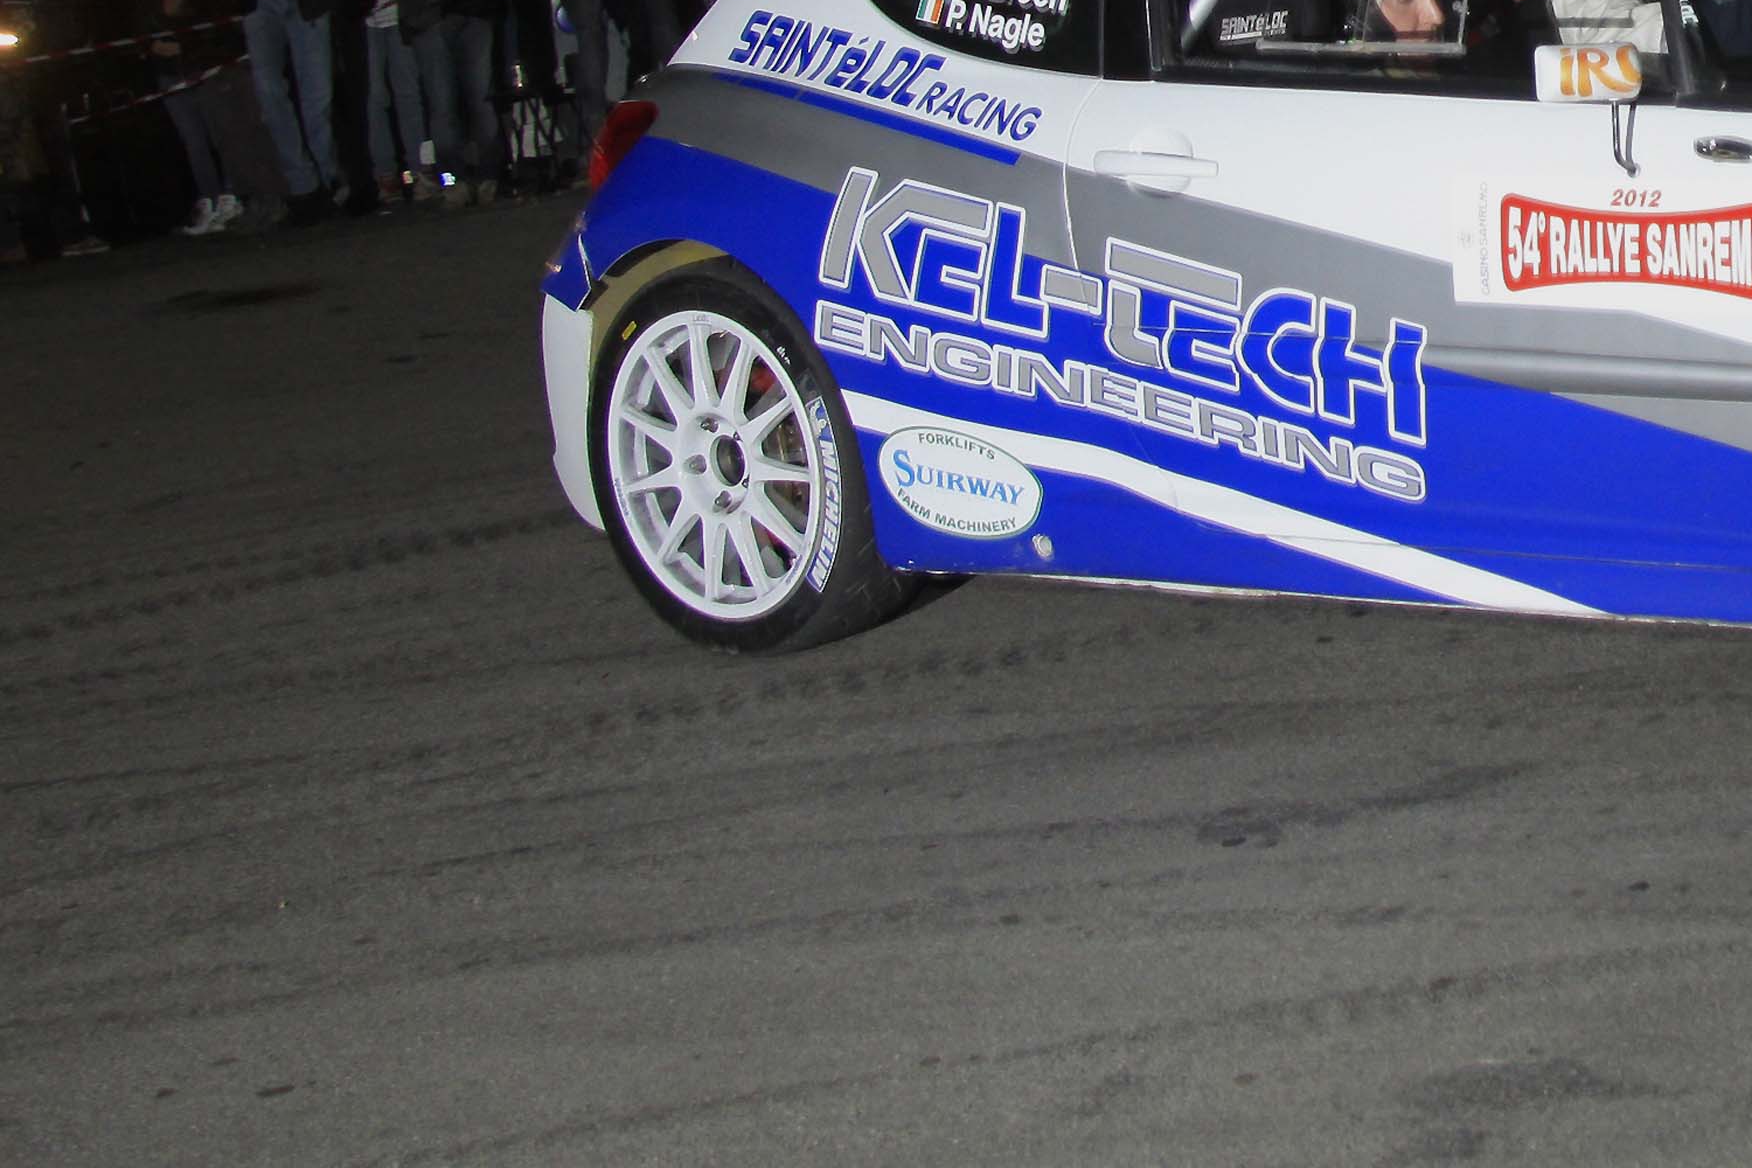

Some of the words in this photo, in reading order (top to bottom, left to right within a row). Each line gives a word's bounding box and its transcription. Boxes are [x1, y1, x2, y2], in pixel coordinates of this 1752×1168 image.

[945, 0, 966, 30] P.
[970, 4, 1047, 50] Nagle
[915, 82, 1043, 141] RACING
[1610, 188, 1662, 209] 2012
[1479, 248, 1491, 296] CASINO
[1549, 215, 1641, 275] RALLYE
[814, 299, 1427, 502] ENGINEERING
[916, 432, 996, 461] FORKLIFTS
[892, 448, 1025, 507] SUIRWAY
[808, 440, 842, 590] MICHELIN
[896, 487, 932, 524] FARM
[934, 513, 1018, 535] MACHINERY
